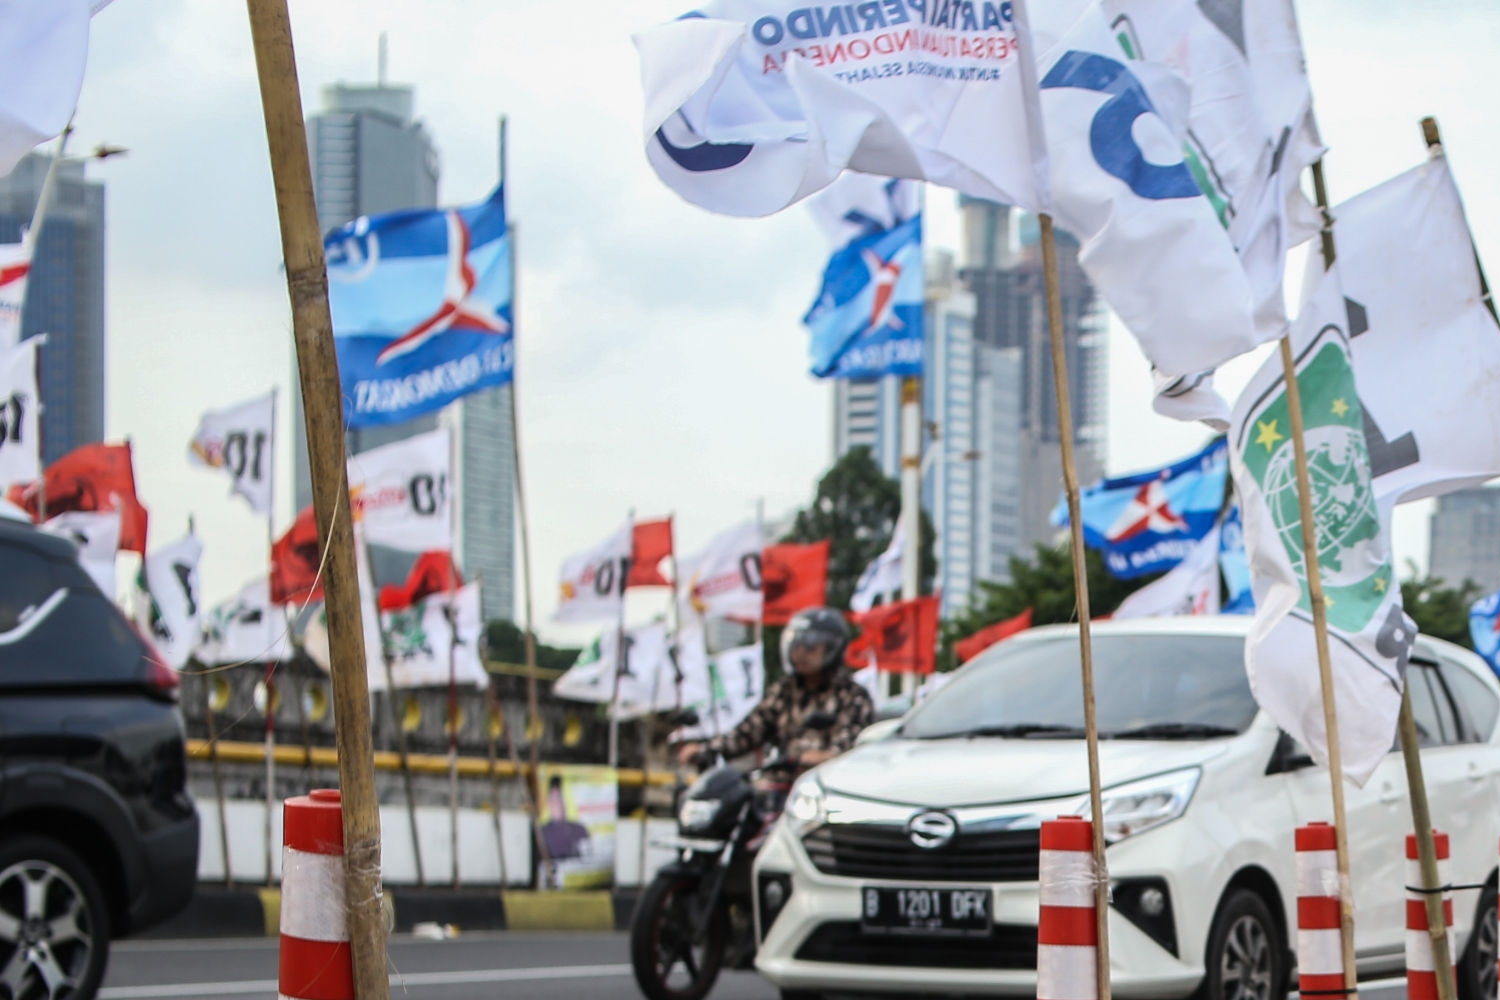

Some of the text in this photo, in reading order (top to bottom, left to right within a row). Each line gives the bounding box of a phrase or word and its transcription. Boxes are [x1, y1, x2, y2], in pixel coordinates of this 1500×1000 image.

[865, 889, 988, 918] B 1201 DFK
